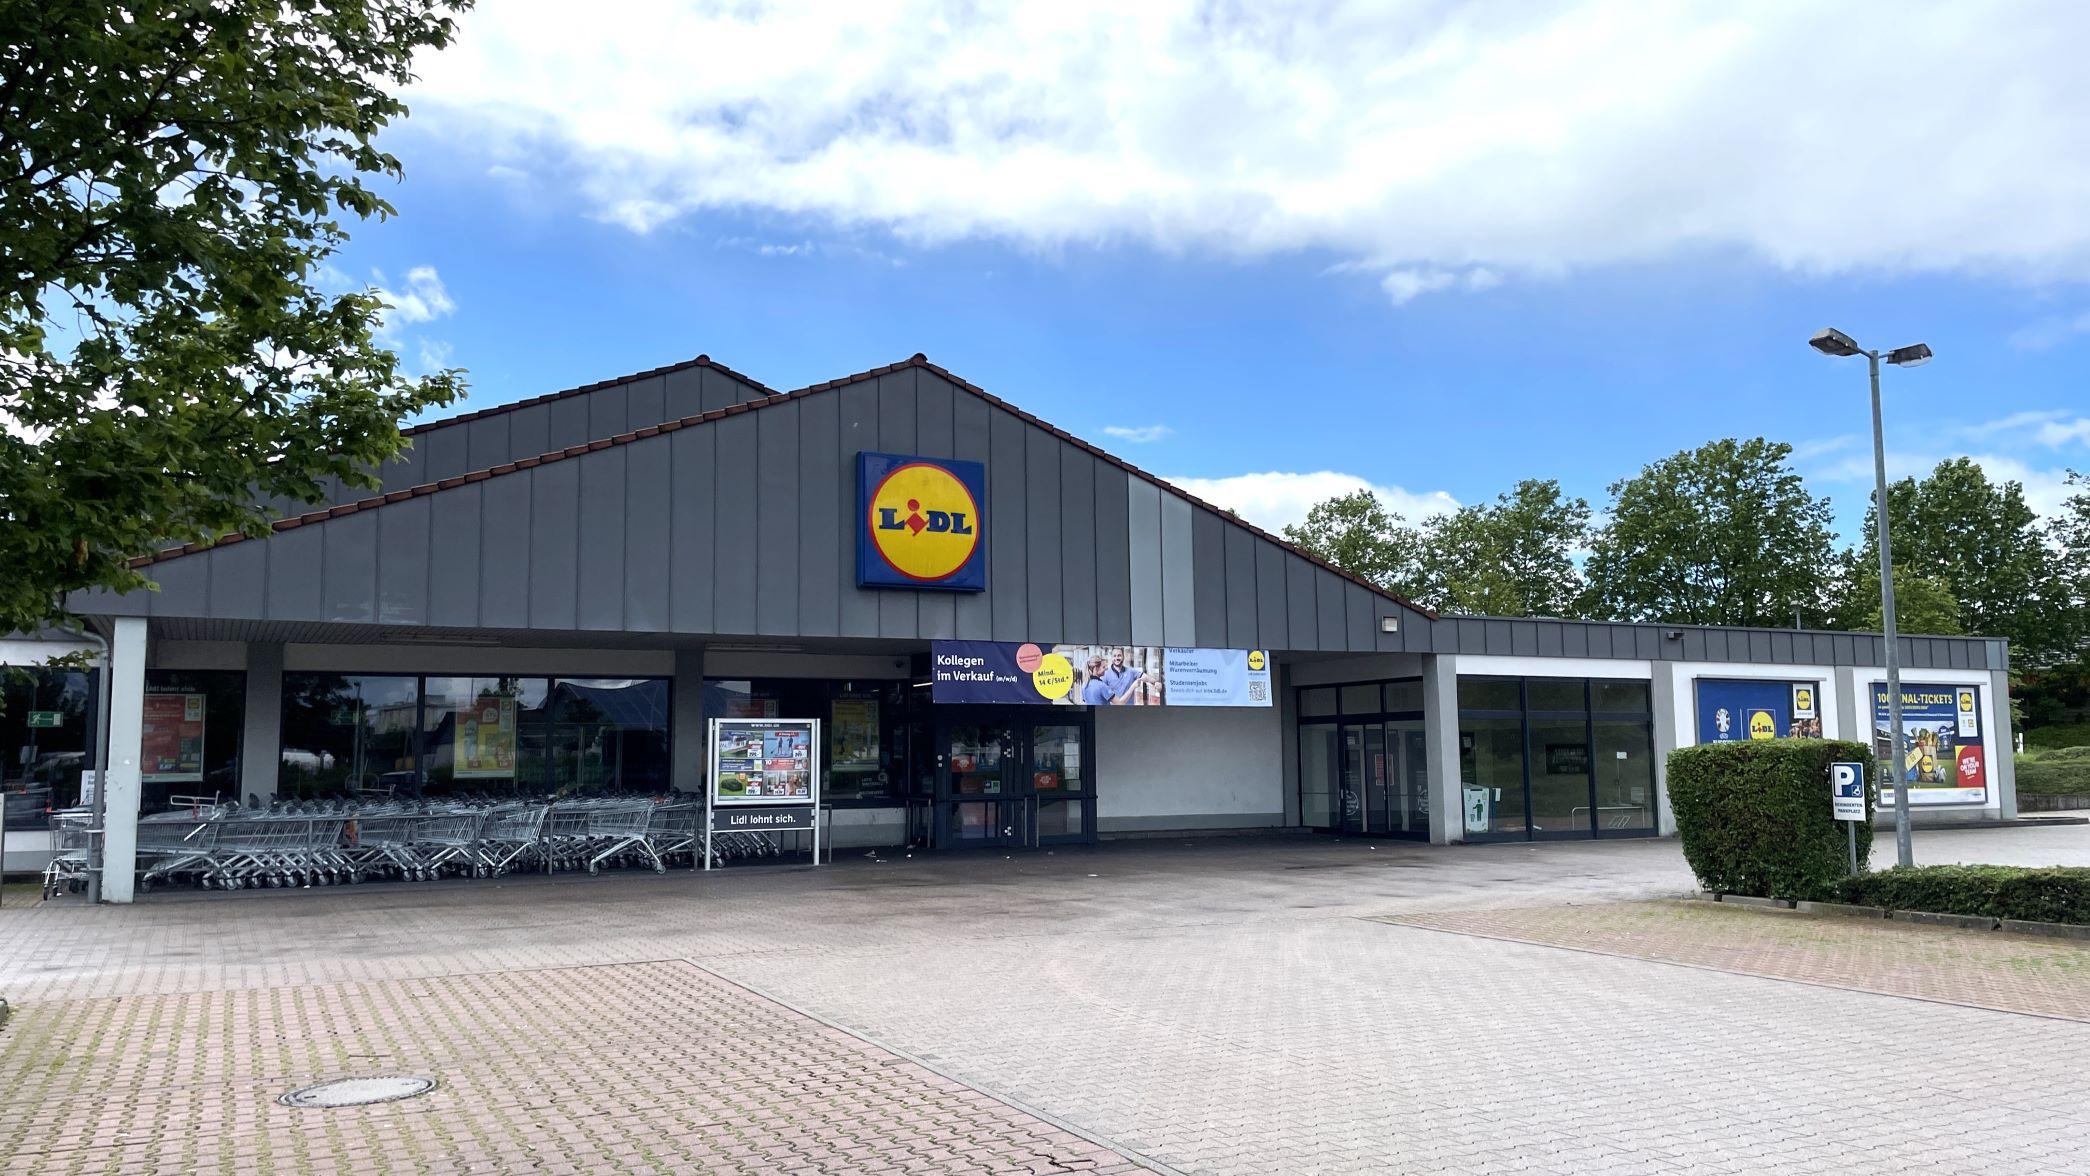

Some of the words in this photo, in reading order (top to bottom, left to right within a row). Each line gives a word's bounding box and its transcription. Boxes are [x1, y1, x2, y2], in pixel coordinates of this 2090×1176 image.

[937, 655, 984, 668] Kollegen
[937, 671, 951, 681] im
[953, 671, 995, 682] Verkauf
[996, 675, 1018, 683] (m/w/d)
[1901, 693, 1953, 705] NAL-TICKETS
[1833, 766, 1855, 796] P
[730, 815, 747, 825] Lidl
[750, 814, 773, 824] lohnt
[775, 814, 796, 823] sich.
